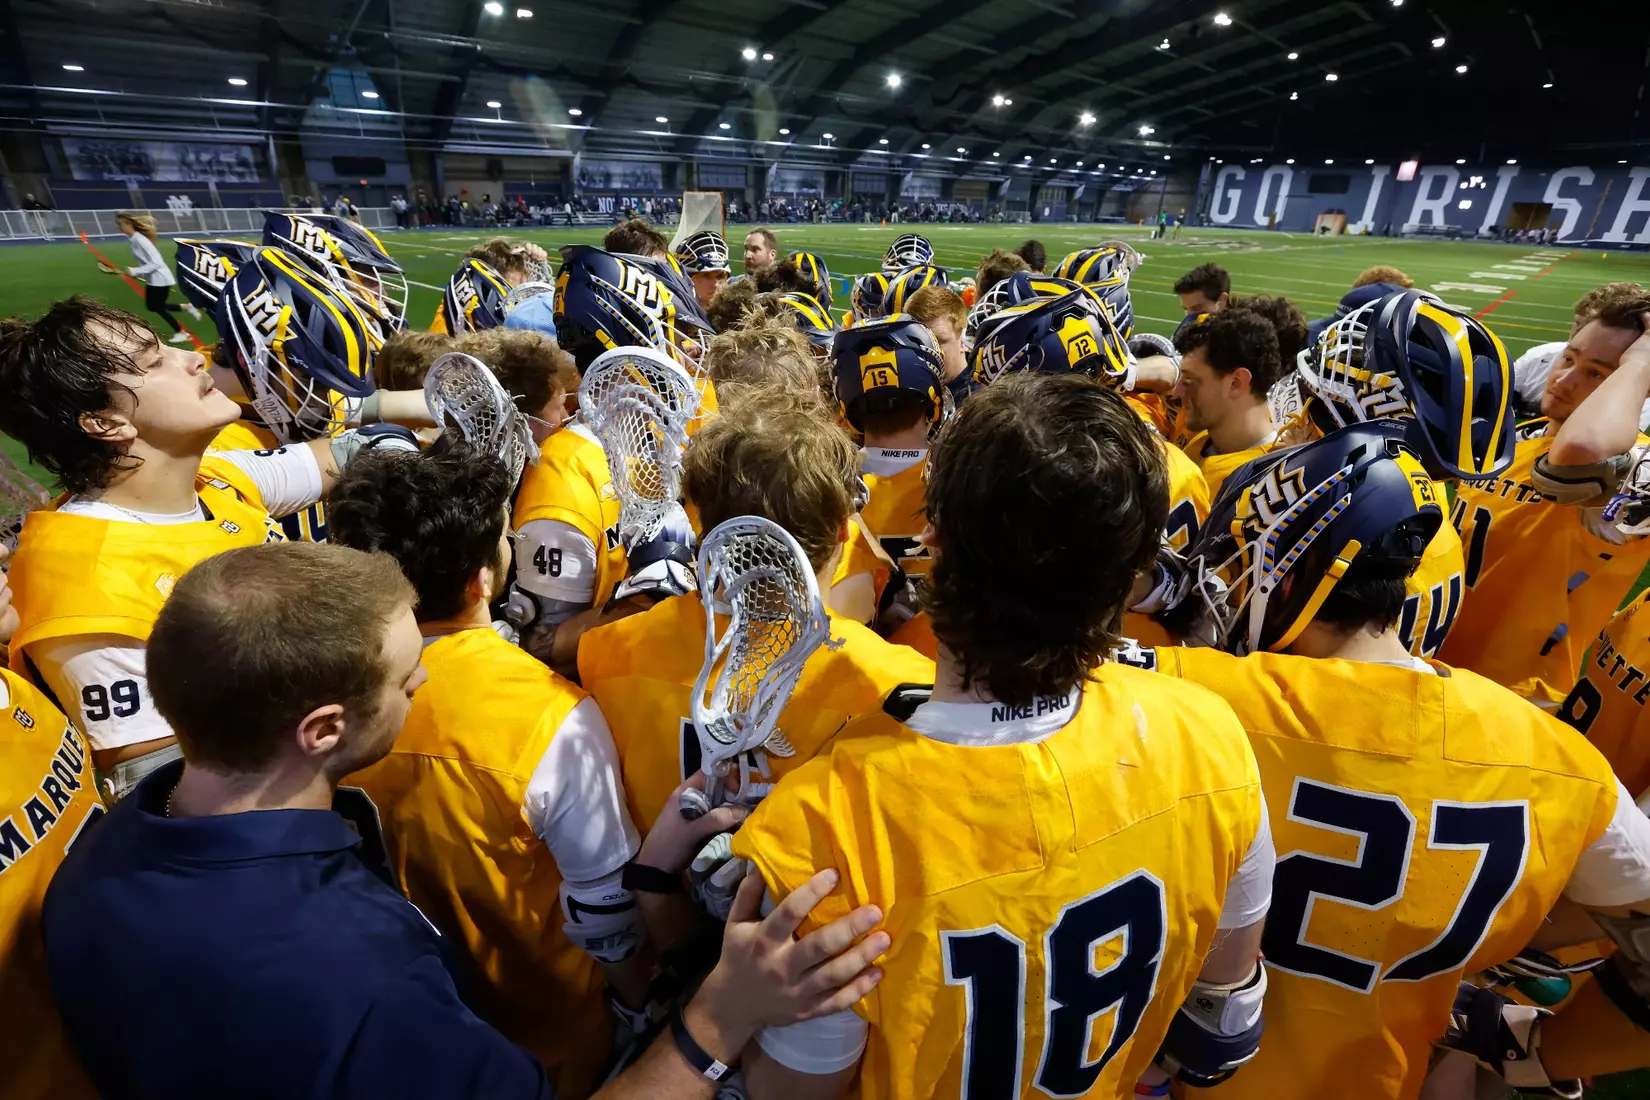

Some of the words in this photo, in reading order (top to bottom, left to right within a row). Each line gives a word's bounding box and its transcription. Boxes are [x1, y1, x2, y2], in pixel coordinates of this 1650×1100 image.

[1210, 165, 1294, 226] GO
[1075, 339, 1091, 358] 12
[870, 370, 889, 387] 15
[881, 450, 901, 458] NIKE
[901, 450, 920, 458] PRO
[533, 545, 563, 578] 48
[82, 679, 141, 722] 99
[991, 705, 1034, 723] NIKE
[1036, 692, 1071, 717] PRO
[0, 722, 85, 875] MARQUE
[1260, 775, 1530, 995] 27
[939, 867, 1168, 1100] 18
